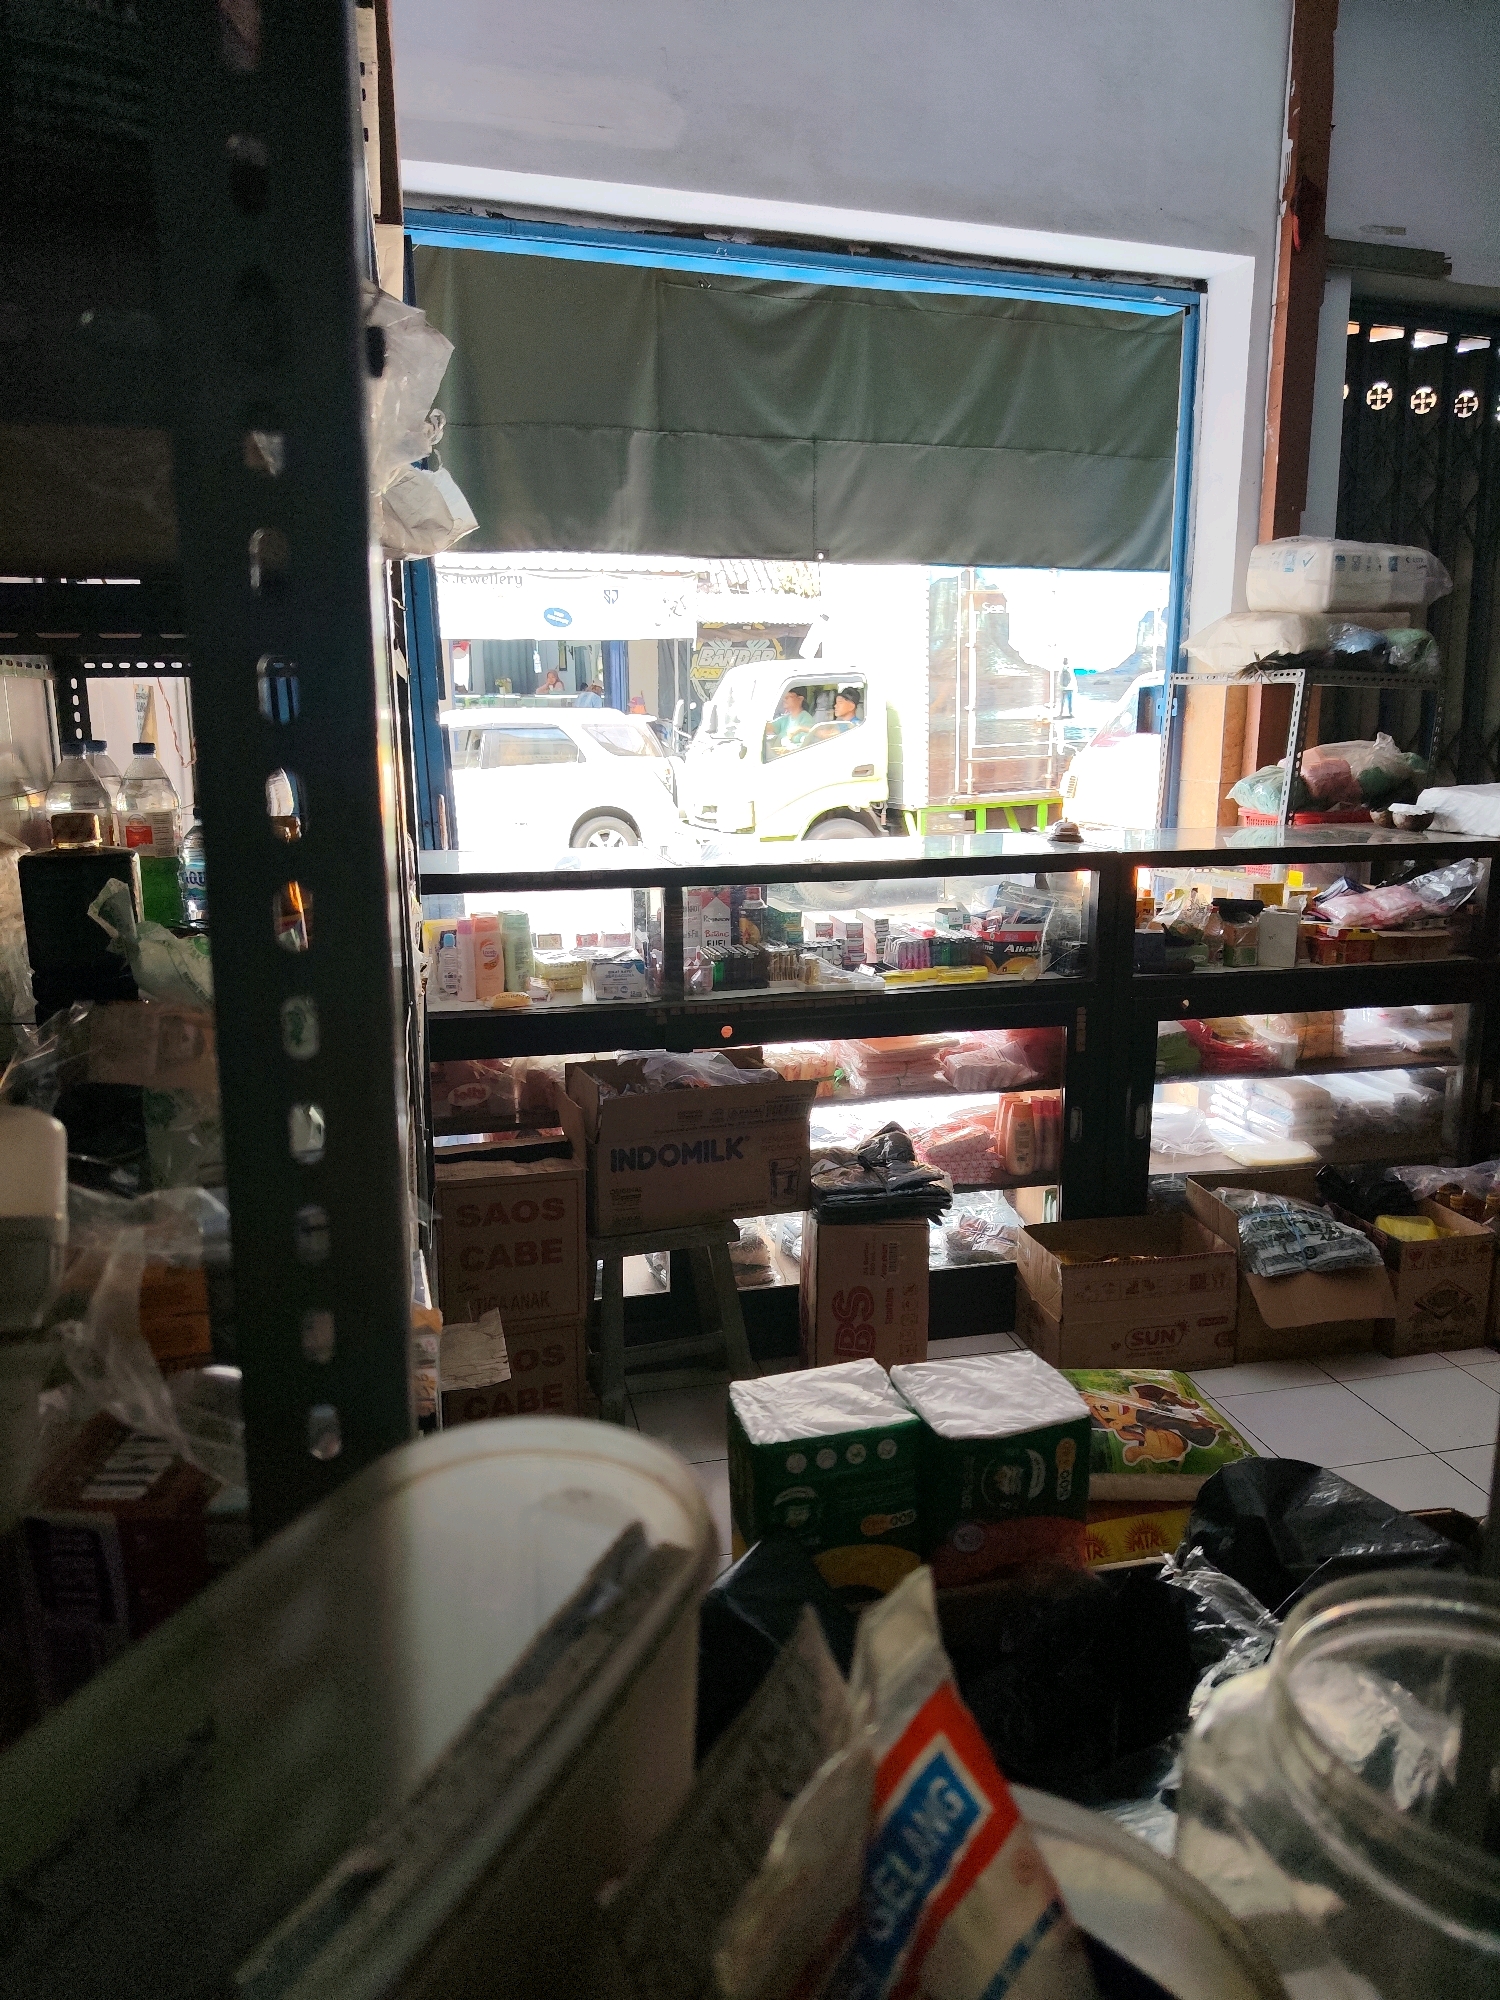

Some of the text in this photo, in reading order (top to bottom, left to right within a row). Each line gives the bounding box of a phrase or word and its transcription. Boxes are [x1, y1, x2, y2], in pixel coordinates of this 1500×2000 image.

[610, 1135, 745, 1173] INDOMILK
[456, 1197, 565, 1228] SAOS
[459, 1238, 564, 1272] CABE
[1130, 1328, 1176, 1347] SUN
[512, 1344, 566, 1372] OS
[463, 1383, 564, 1420] CABE
